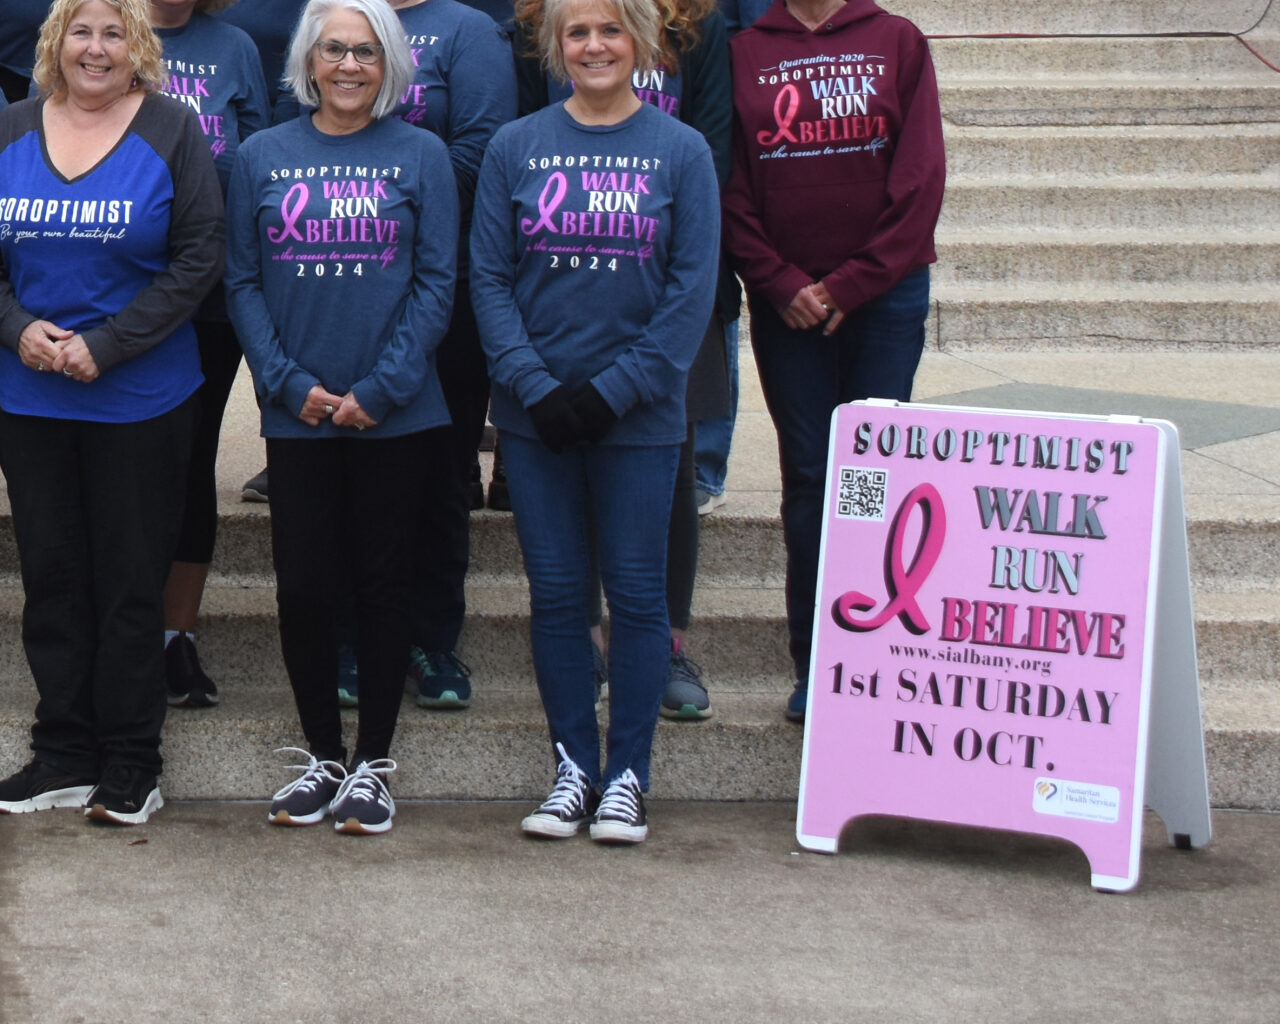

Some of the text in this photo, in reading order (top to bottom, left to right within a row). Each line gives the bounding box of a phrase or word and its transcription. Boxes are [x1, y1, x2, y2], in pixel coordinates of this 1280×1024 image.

[779, 53, 864, 71] Quarantine 2020
[631, 69, 664, 91] UN
[758, 64, 885, 84] SOROPTIMIST
[810, 76, 877, 100] WALK
[821, 94, 868, 119] RUN
[799, 116, 888, 144] BELIEVE
[528, 155, 661, 170] SOROPTIMIST
[771, 145, 788, 158] the
[790, 149, 821, 158] cause
[836, 146, 861, 154] save
[271, 166, 401, 182] SOROPTIMIST
[581, 171, 650, 195] WALK
[323, 180, 389, 200] WALK
[330, 197, 379, 218] RUN
[587, 191, 640, 214] RUN
[0, 224, 13, 240] Be
[15, 231, 39, 244] your
[69, 226, 126, 243] beautiful
[305, 218, 400, 244] BELIEVE
[561, 211, 659, 243] BELIEVE
[281, 246, 294, 261] the
[296, 253, 327, 261] cause
[329, 251, 341, 260] to
[585, 244, 597, 252] to
[297, 263, 363, 276] 2024
[550, 255, 617, 271] 2024
[853, 422, 1134, 475] SOROPTIMIST
[973, 485, 1108, 539] WALK
[990, 545, 1084, 595] RUN
[938, 597, 1125, 659] BELIEVE
[889, 643, 1052, 676] www.sialbany.org
[828, 663, 1120, 726] 1st SATURDAY
[891, 719, 1055, 772] IN OCT.
